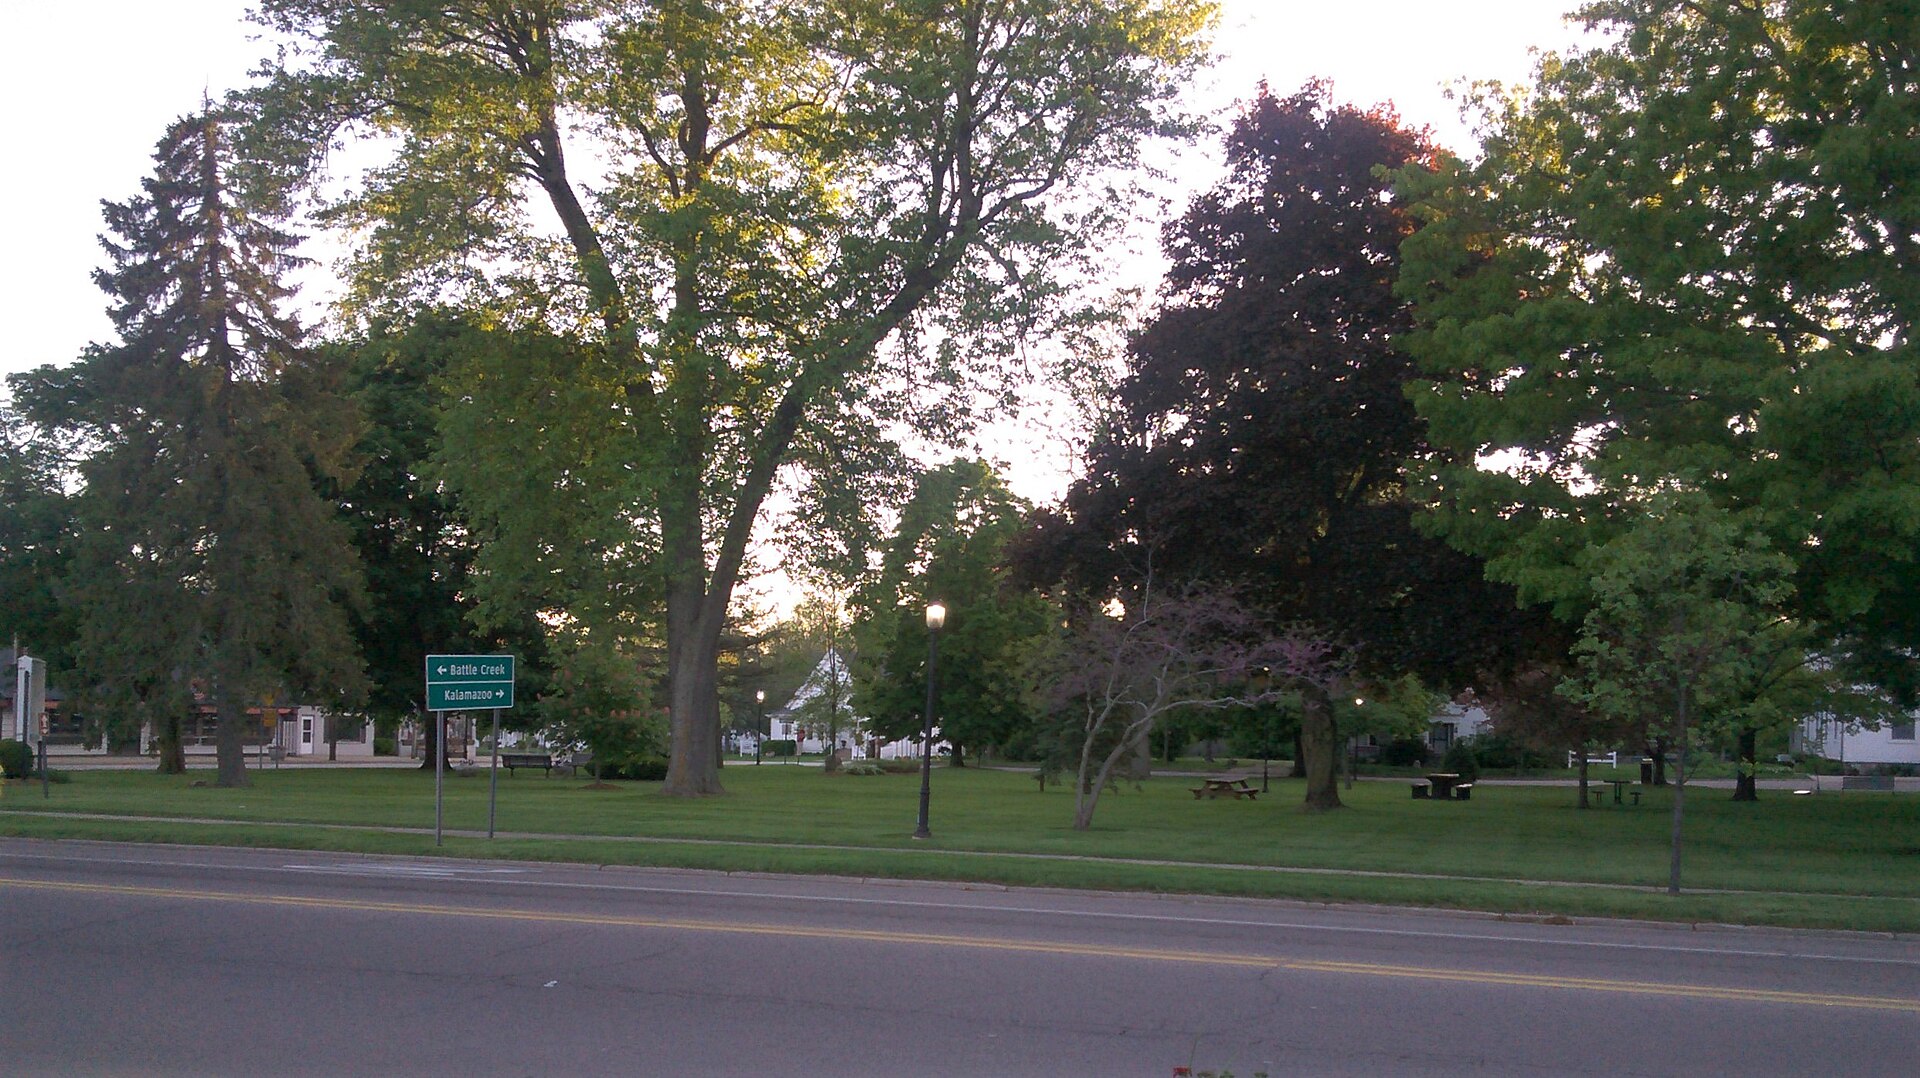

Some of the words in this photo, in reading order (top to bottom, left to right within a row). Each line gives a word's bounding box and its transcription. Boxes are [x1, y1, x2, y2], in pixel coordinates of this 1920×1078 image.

[450, 664, 478, 675] Battle
[480, 664, 505, 675] Creek
[444, 689, 492, 701] Kalamazoo
